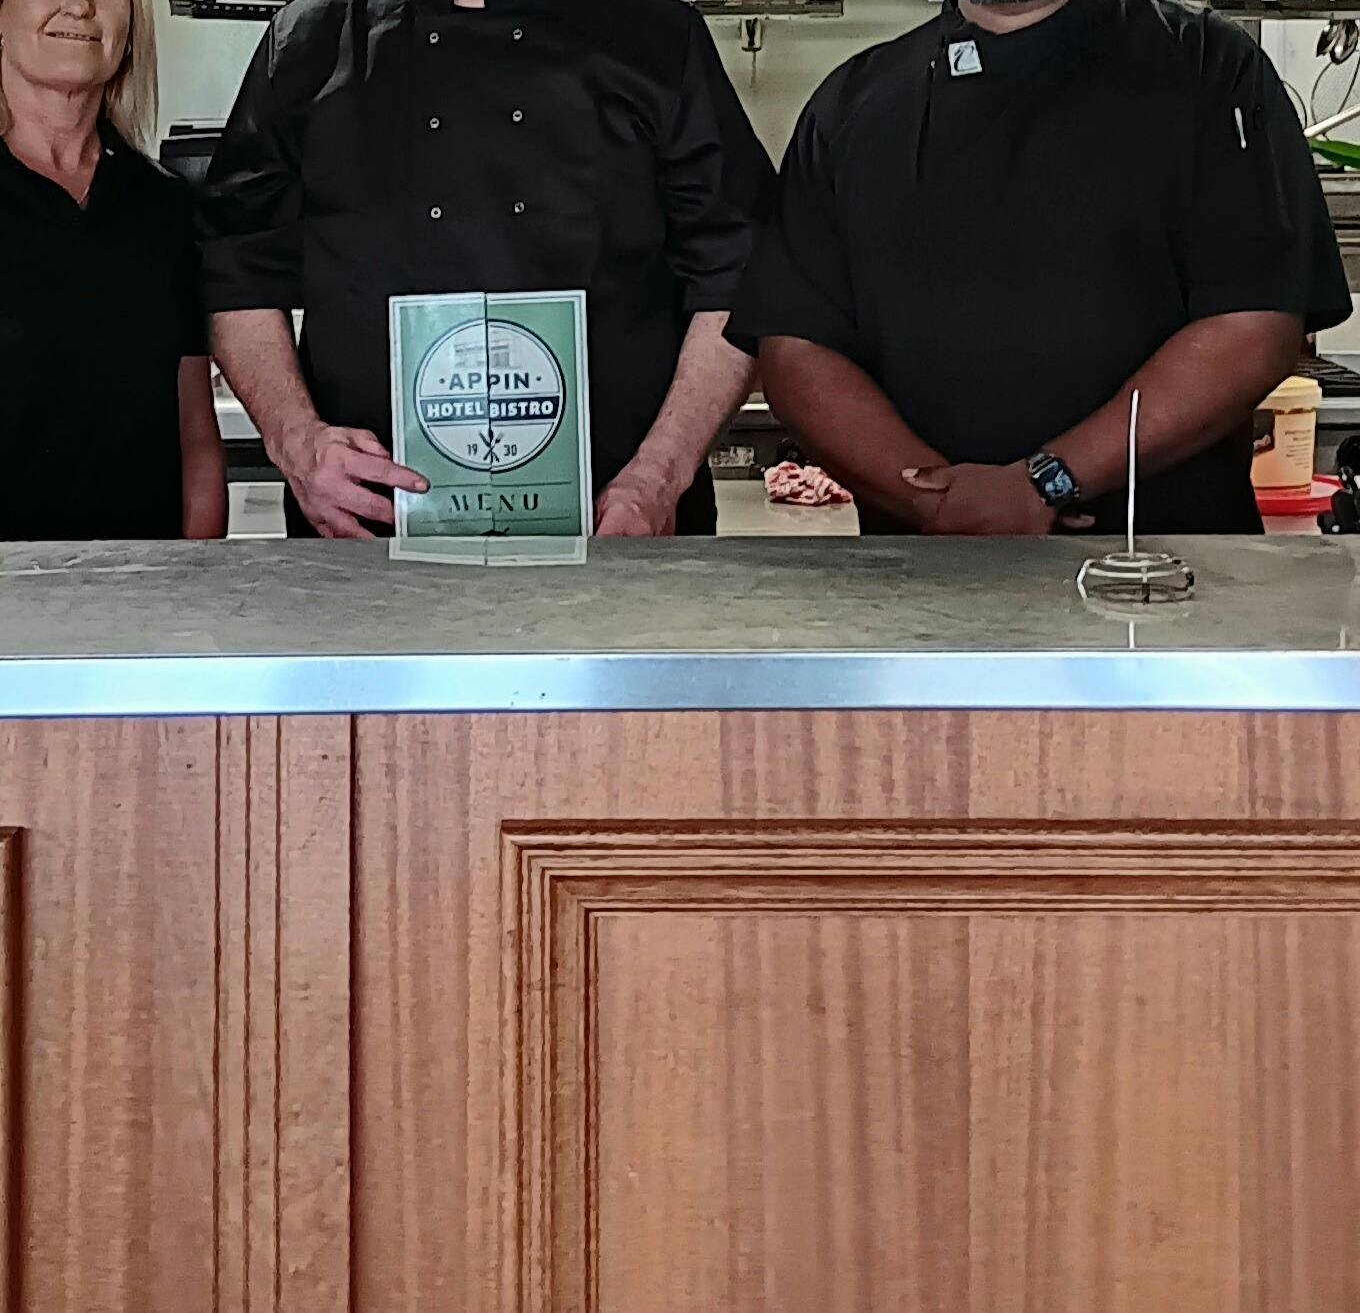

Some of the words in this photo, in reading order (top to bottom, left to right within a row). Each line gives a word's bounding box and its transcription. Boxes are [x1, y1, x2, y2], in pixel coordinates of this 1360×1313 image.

[448, 372, 530, 390] APPIN
[426, 400, 486, 418] HOTEL
[490, 399, 555, 418] BISTRO
[466, 444, 479, 456] 19
[504, 443, 518, 457] 30
[449, 493, 540, 512] MENU
